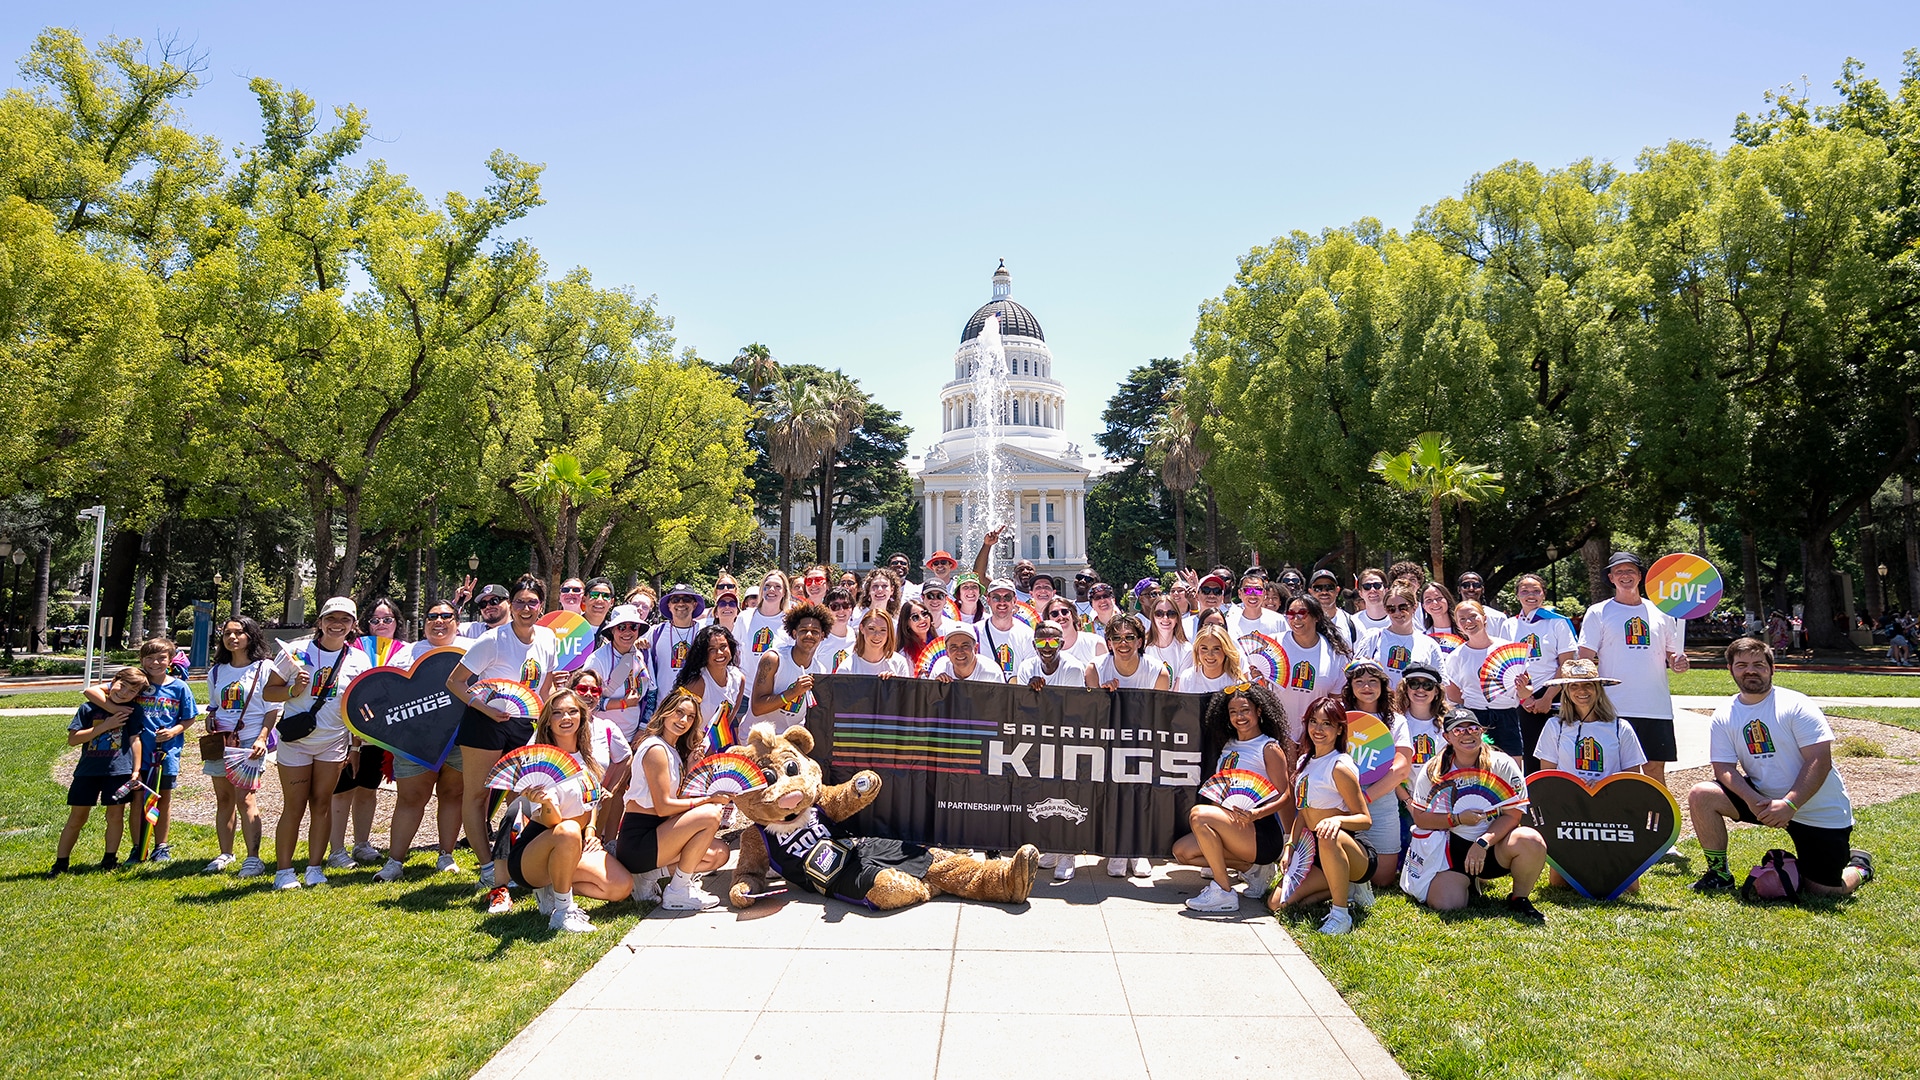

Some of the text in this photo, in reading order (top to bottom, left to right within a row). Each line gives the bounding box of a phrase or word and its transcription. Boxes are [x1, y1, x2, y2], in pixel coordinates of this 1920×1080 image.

[1658, 580, 1707, 604] LOVE
[385, 694, 452, 726] KINGS
[388, 691, 445, 714] SACRAMENTO
[1003, 723, 1188, 744] SACRAMENTO
[988, 740, 1202, 787] KINGS
[1575, 758, 1604, 772] PRIDE
[947, 802, 1001, 812] PARTNERSHIP
[1002, 804, 1022, 812] WITH
[1035, 805, 1080, 816] SIERRA NEVADA
[1560, 821, 1629, 829] SACRAMENTO
[1556, 827, 1635, 842] KINGS
